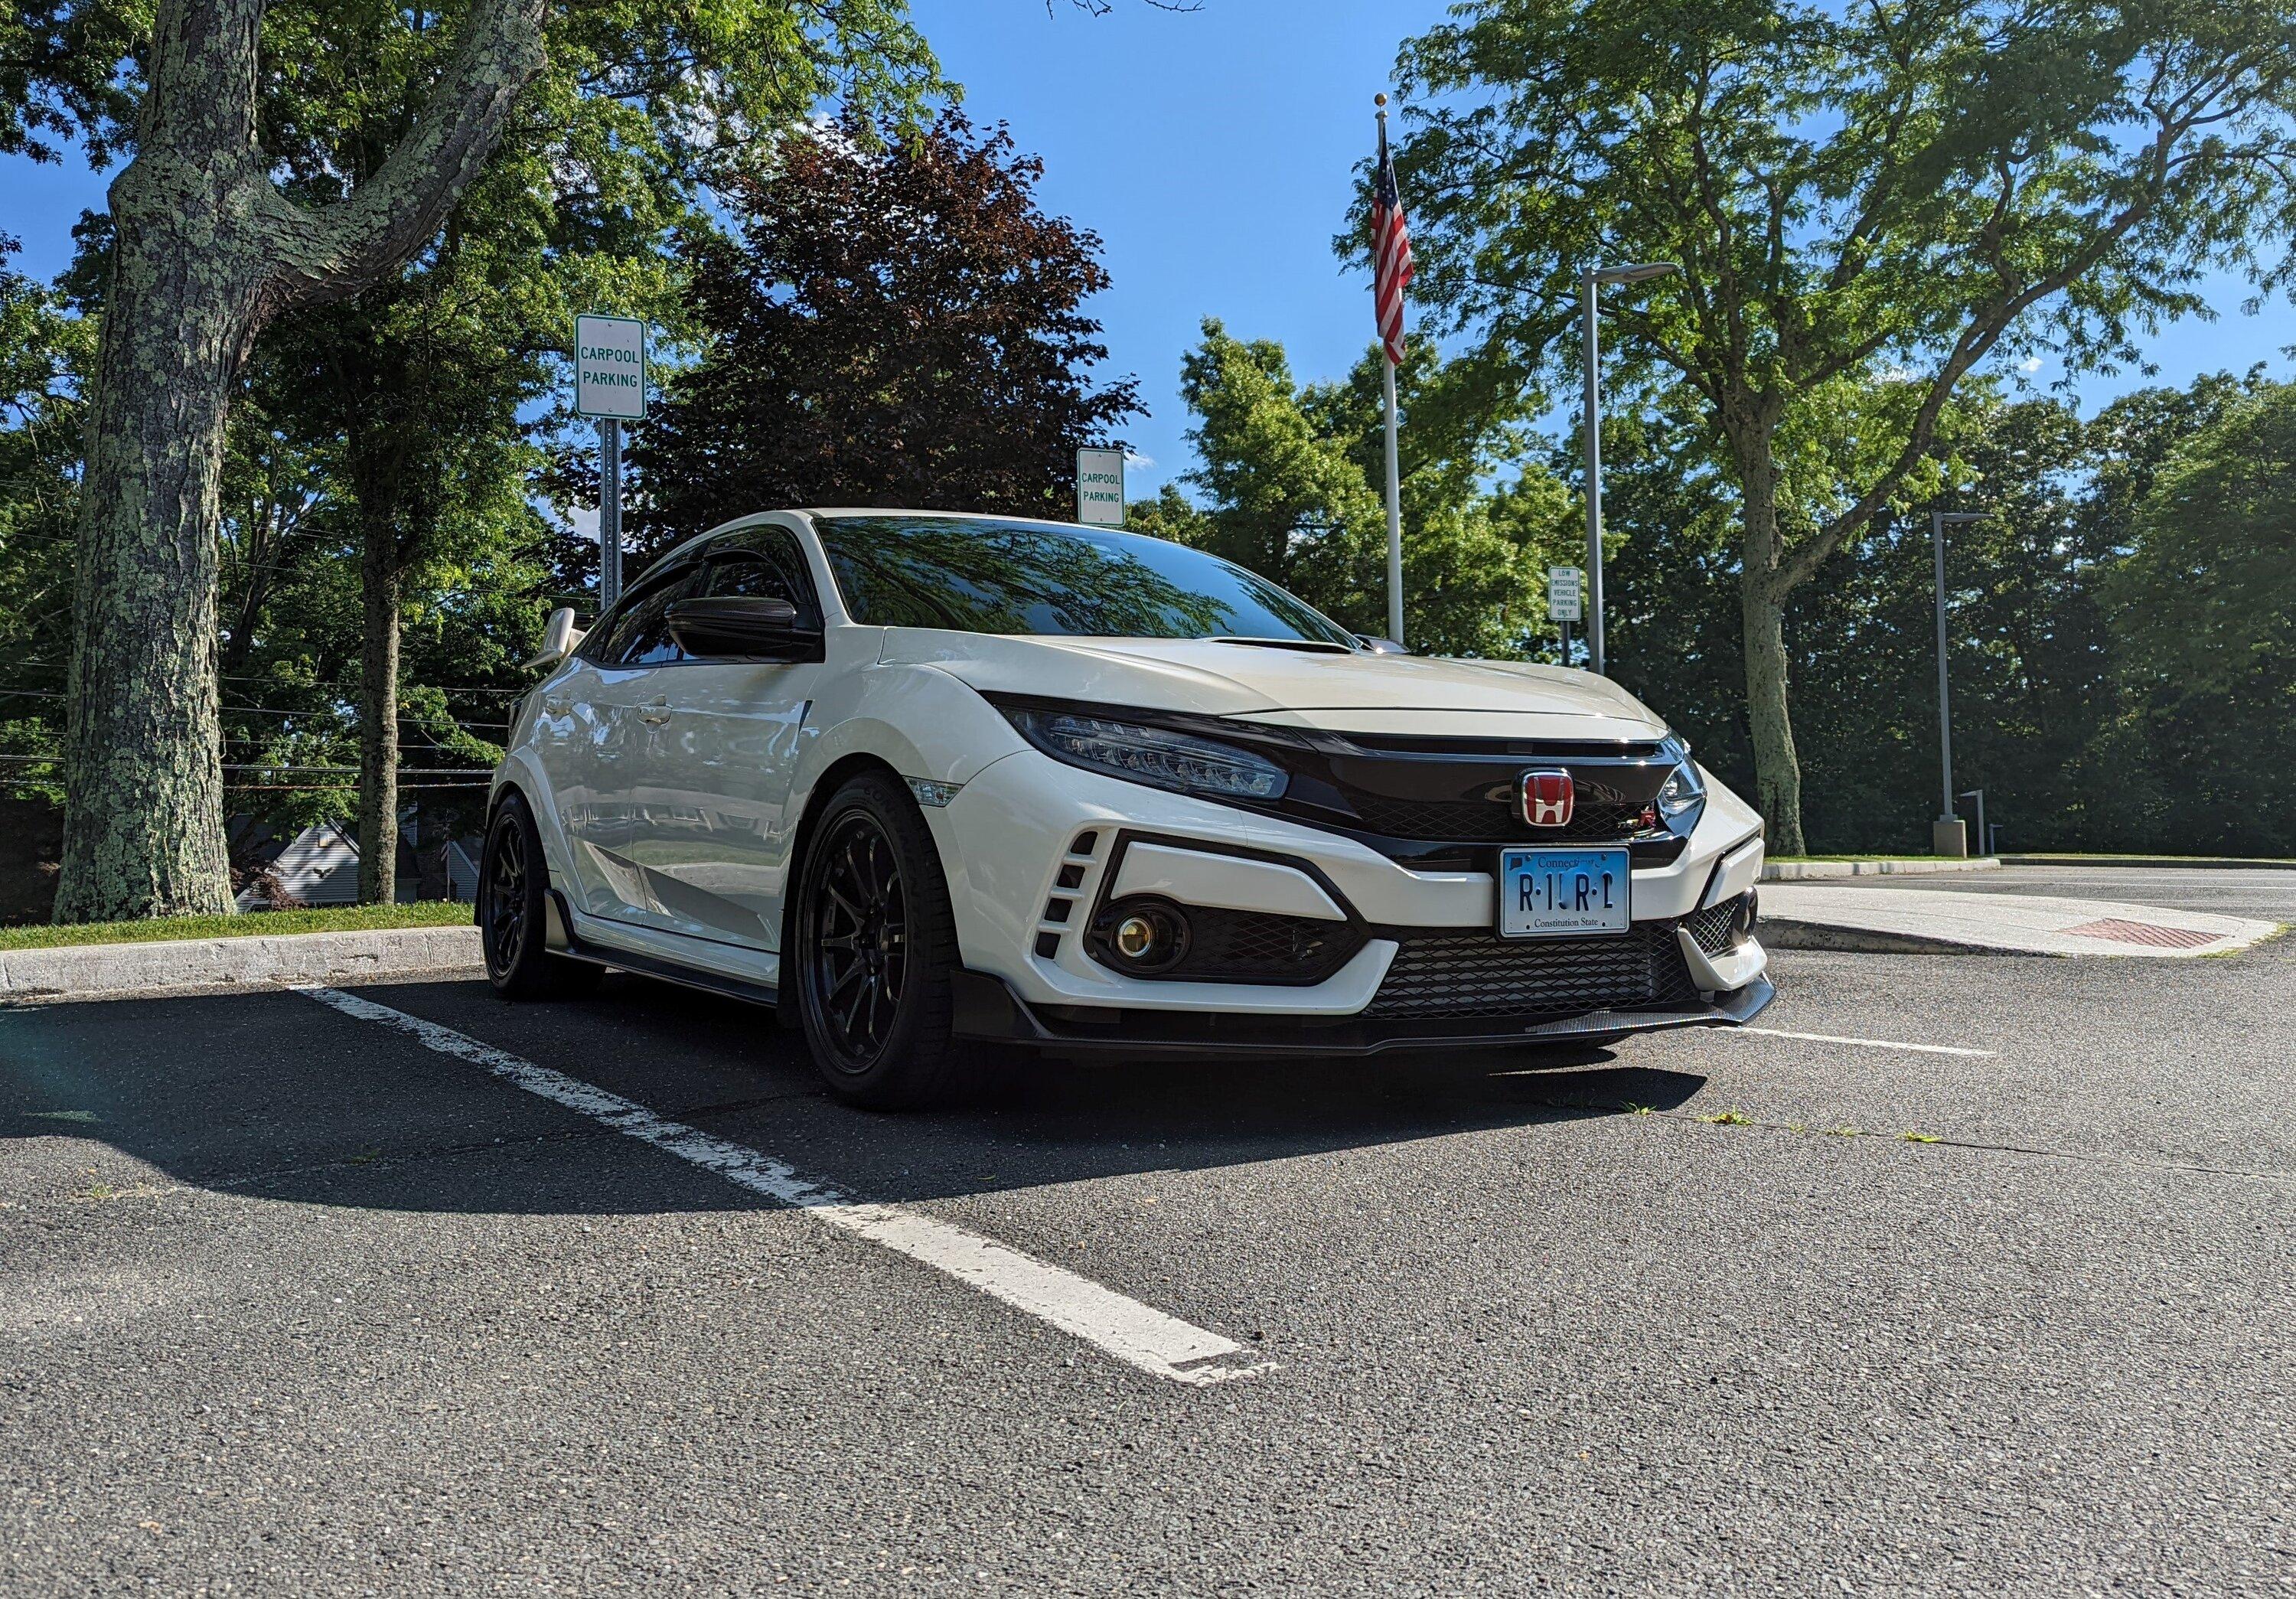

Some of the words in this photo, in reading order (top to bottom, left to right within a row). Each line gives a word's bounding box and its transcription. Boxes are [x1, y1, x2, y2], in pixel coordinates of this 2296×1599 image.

[581, 346, 640, 364] CARPOOL
[583, 370, 638, 387] PARKING
[1081, 472, 1120, 485] CARPOOL
[1084, 491, 1120, 503] PARKING
[1534, 918, 1580, 928] Constitution
[1580, 917, 1599, 927] State
